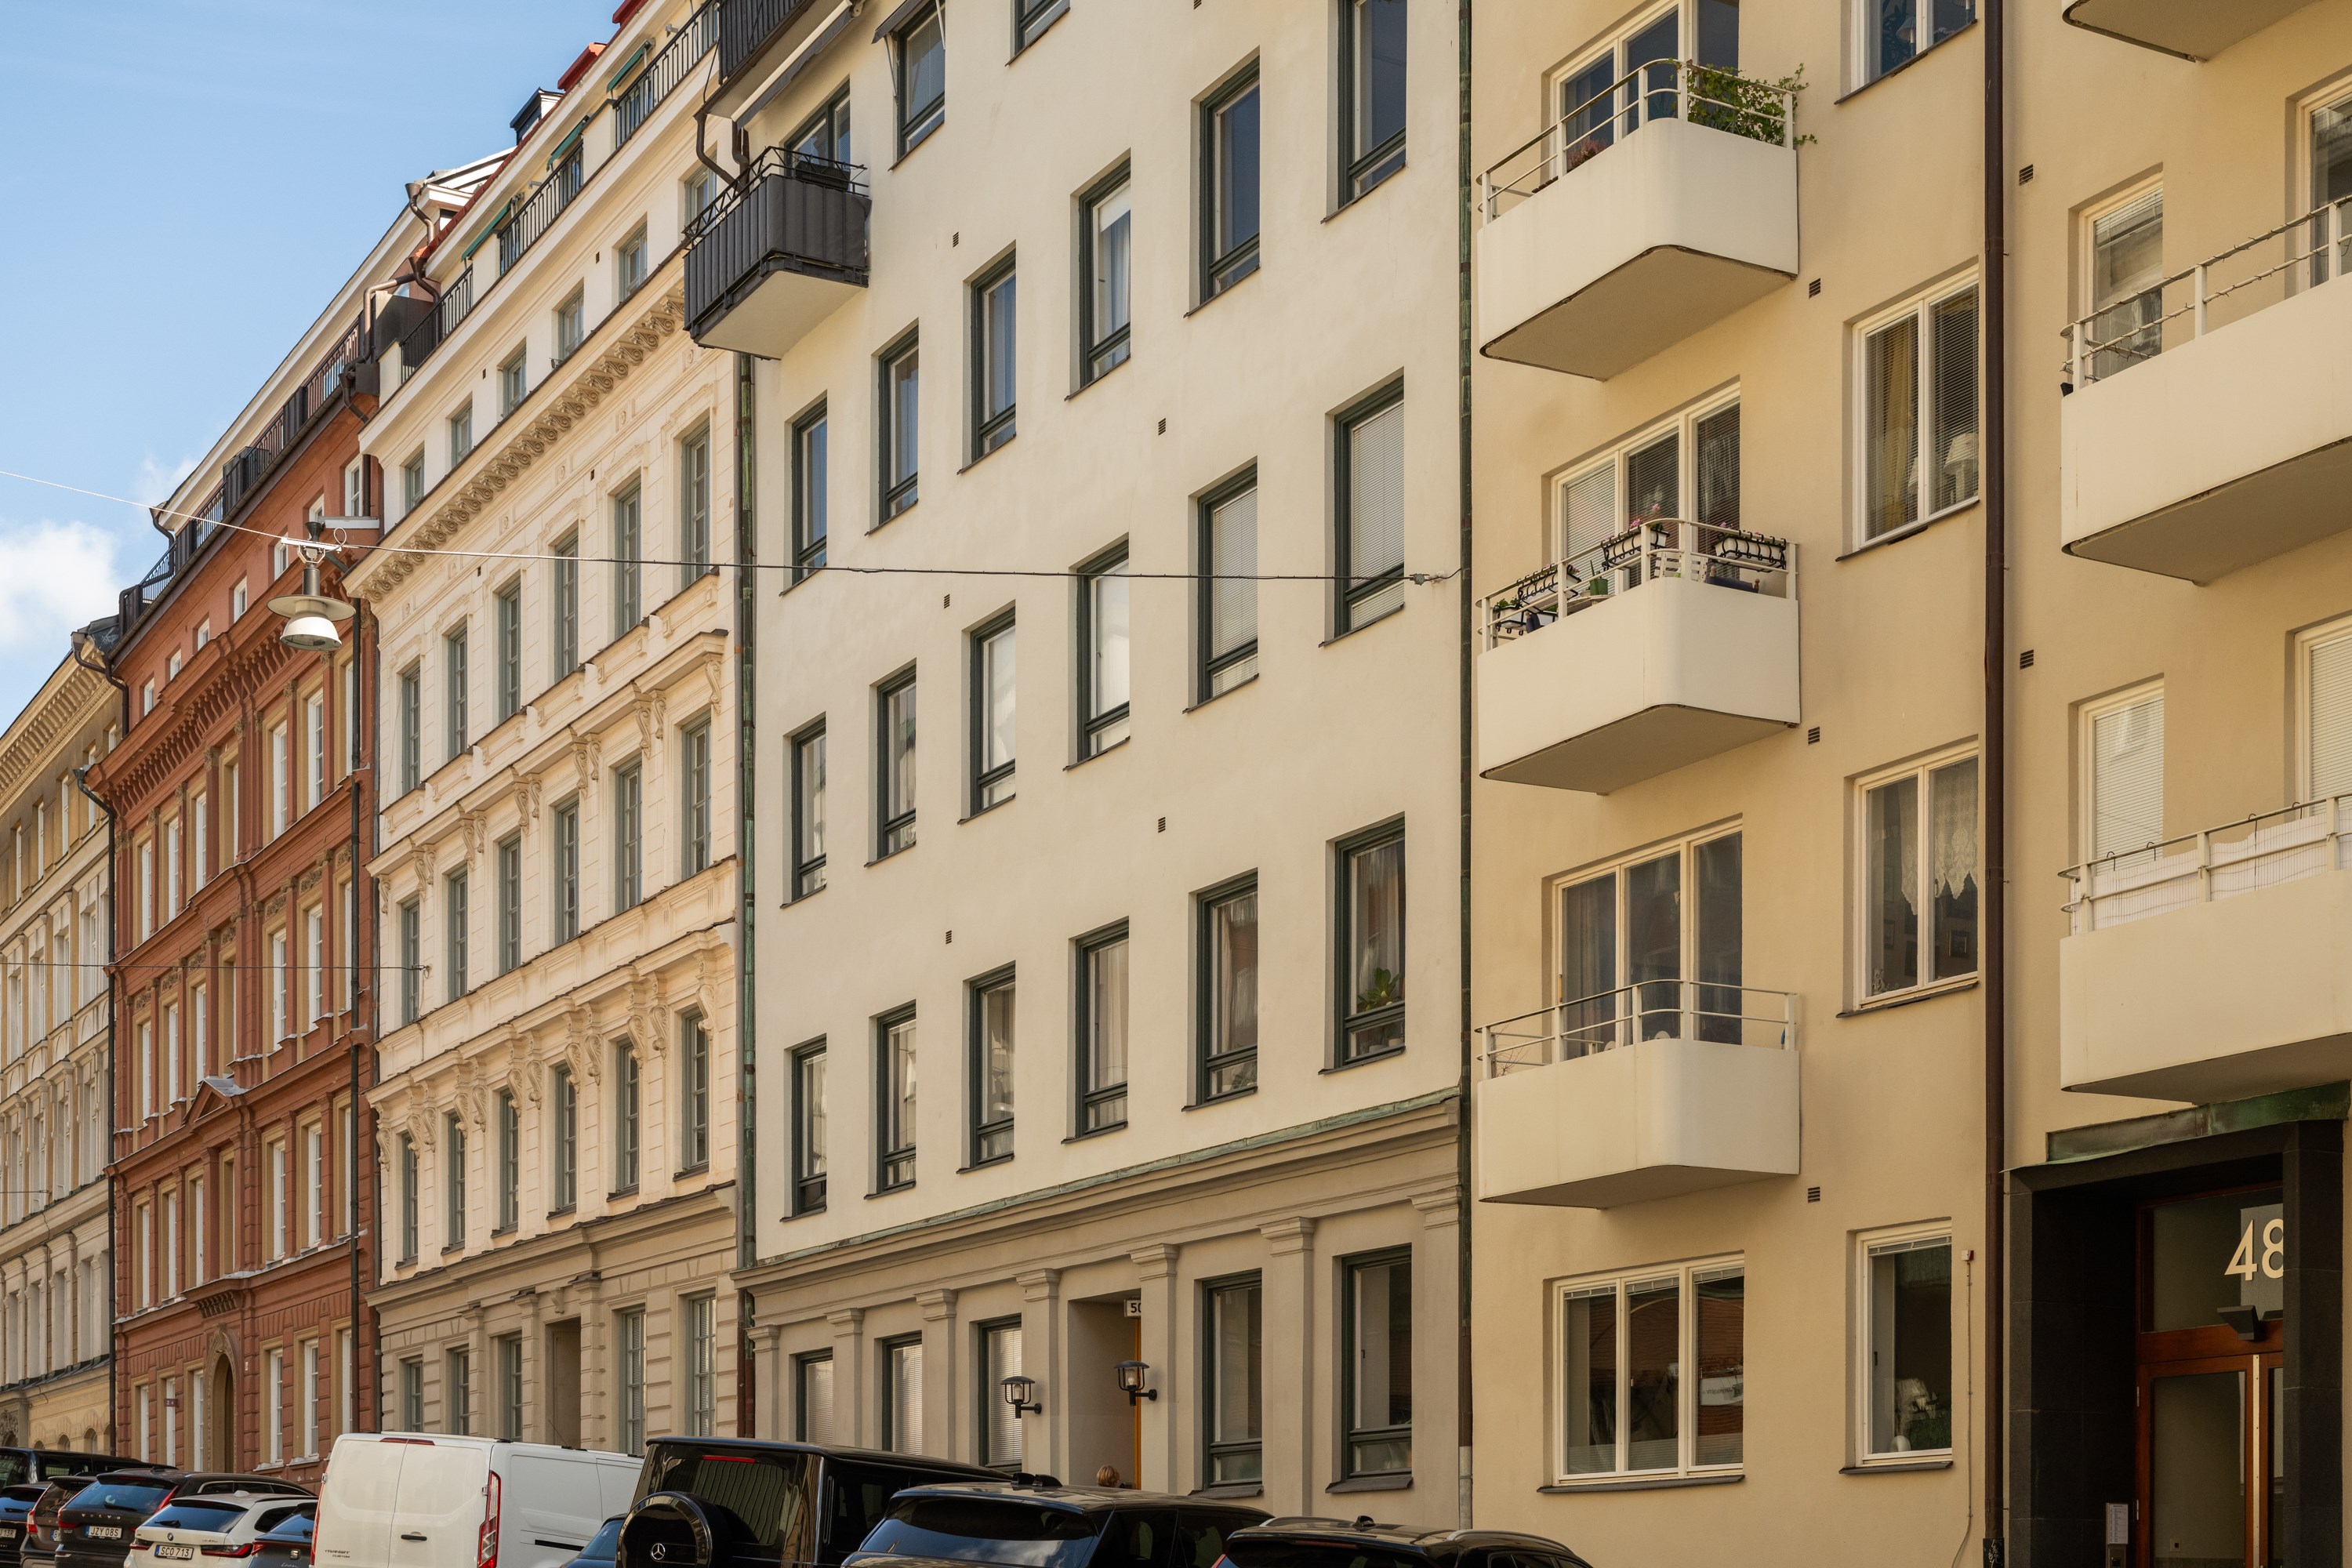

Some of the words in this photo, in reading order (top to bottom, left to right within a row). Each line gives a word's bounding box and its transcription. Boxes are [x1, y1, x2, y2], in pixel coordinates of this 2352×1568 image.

[2224, 1218, 2283, 1281] 48
[90, 1527, 104, 1536] JZY
[105, 1528, 119, 1537] 08S
[161, 1547, 175, 1555] SCO
[176, 1548, 190, 1557] 713
